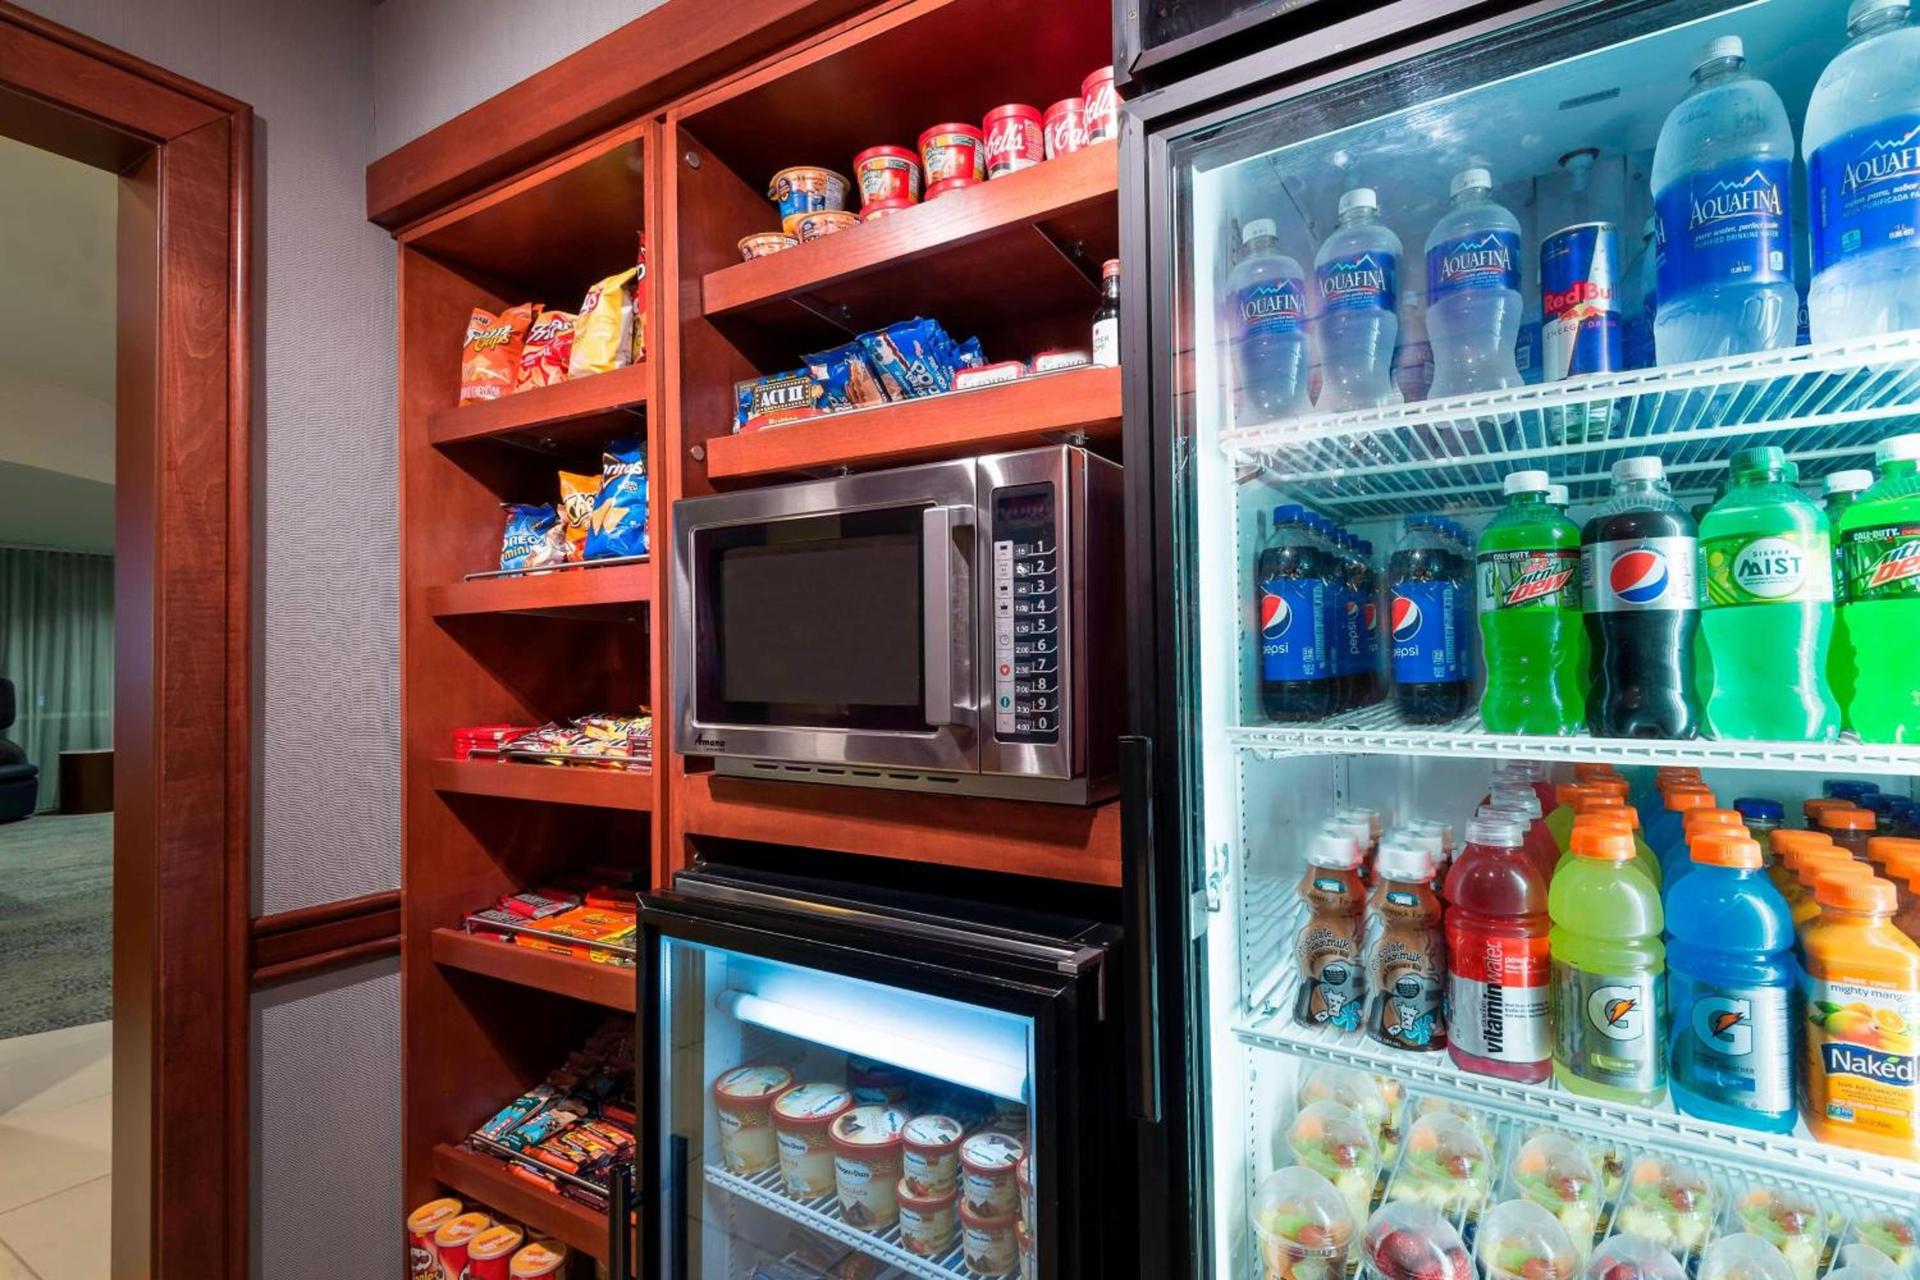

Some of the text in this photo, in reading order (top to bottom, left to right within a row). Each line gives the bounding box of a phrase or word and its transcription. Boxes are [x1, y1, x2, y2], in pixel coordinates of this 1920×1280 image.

[1839, 146, 1920, 196] AQUAFI
[1689, 183, 1783, 231] AQUAFINA
[1440, 246, 1512, 282] AQUAFINA
[1240, 293, 1308, 321] AQUAFINA
[1544, 281, 1583, 317] Red
[760, 384, 804, 408] ACT II
[1037, 540, 1044, 552] 1
[1752, 549, 1790, 558] SIERRA
[1037, 560, 1045, 572] 2
[1738, 557, 1803, 577] MIST
[1037, 579, 1045, 592] 3
[1037, 599, 1046, 611] 4
[1038, 618, 1046, 631] 5
[1038, 638, 1047, 651] 6
[1347, 620, 1360, 655] pepsi
[1038, 658, 1047, 670] 7
[1038, 677, 1047, 690] 8
[1039, 697, 1047, 710] 9
[1039, 717, 1048, 729] 0
[694, 733, 726, 747] Amana
[1483, 940, 1504, 1053] vitaminwater
[1830, 983, 1905, 1003] mighty mang
[1588, 985, 1645, 1042] G
[1691, 994, 1753, 1056] G
[1831, 1048, 1914, 1082] Naked
